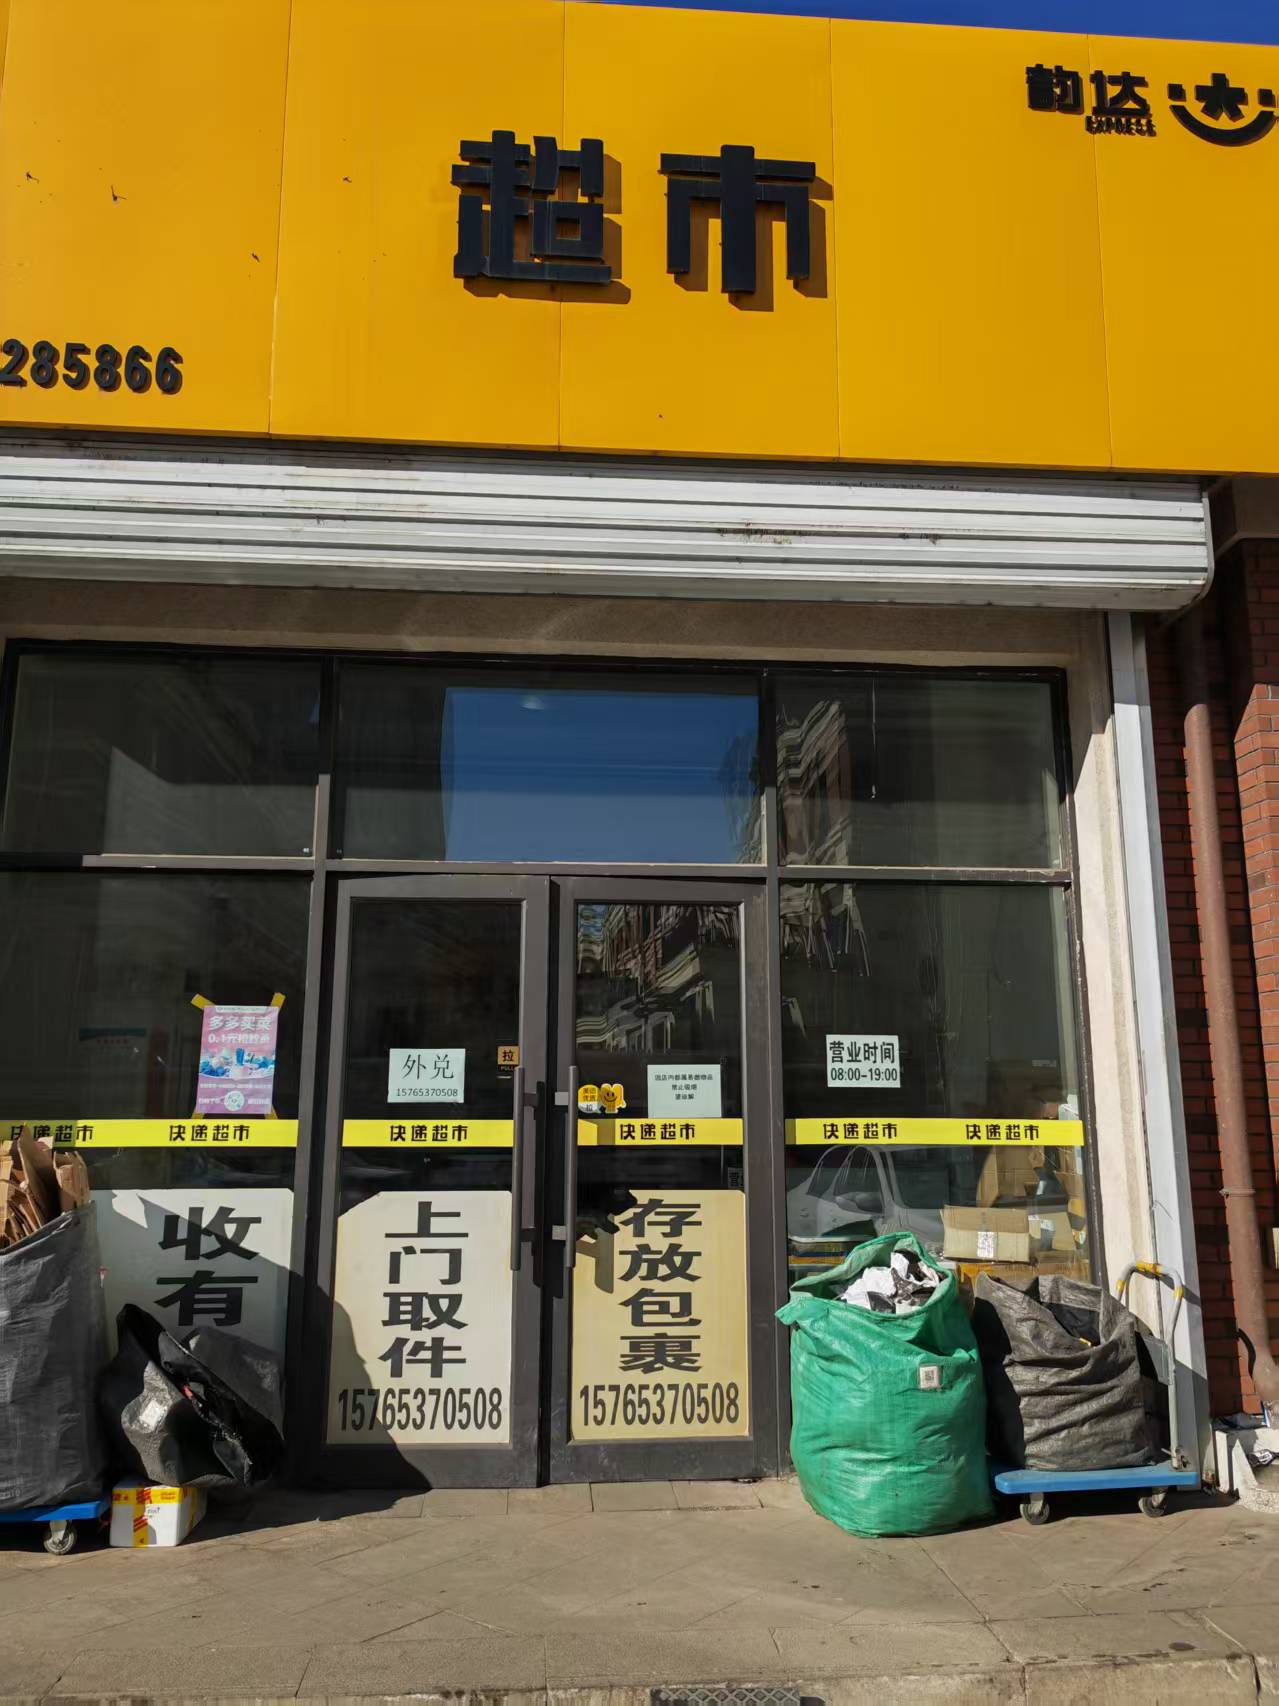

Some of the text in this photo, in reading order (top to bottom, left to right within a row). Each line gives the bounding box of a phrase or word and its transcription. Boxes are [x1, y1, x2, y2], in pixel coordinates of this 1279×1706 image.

[1026, 63, 1151, 116] 韵达
[451, 130, 816, 294] 超市
[0, 338, 183, 394] 285866
[208, 1015, 272, 1031] 多多买菜
[502, 1049, 514, 1062] 拉
[829, 1041, 895, 1064] 营业时间
[401, 1054, 454, 1080] 外兑
[831, 1068, 898, 1081] 08:00-19:00
[397, 1088, 458, 1097] 15765370508
[169, 1124, 251, 1142] 快递超市
[389, 1124, 469, 1142] 快递超市
[619, 1122, 696, 1141] 快递超市
[823, 1122, 898, 1140] 快递超市
[965, 1123, 1040, 1141] 快递超市
[154, 1206, 262, 1348] 收有
[618, 1198, 703, 1375] 存放包裹
[378, 1201, 469, 1379] 上门取件
[339, 1387, 503, 1432] 15765370508
[580, 1382, 740, 1427] 15765370508
